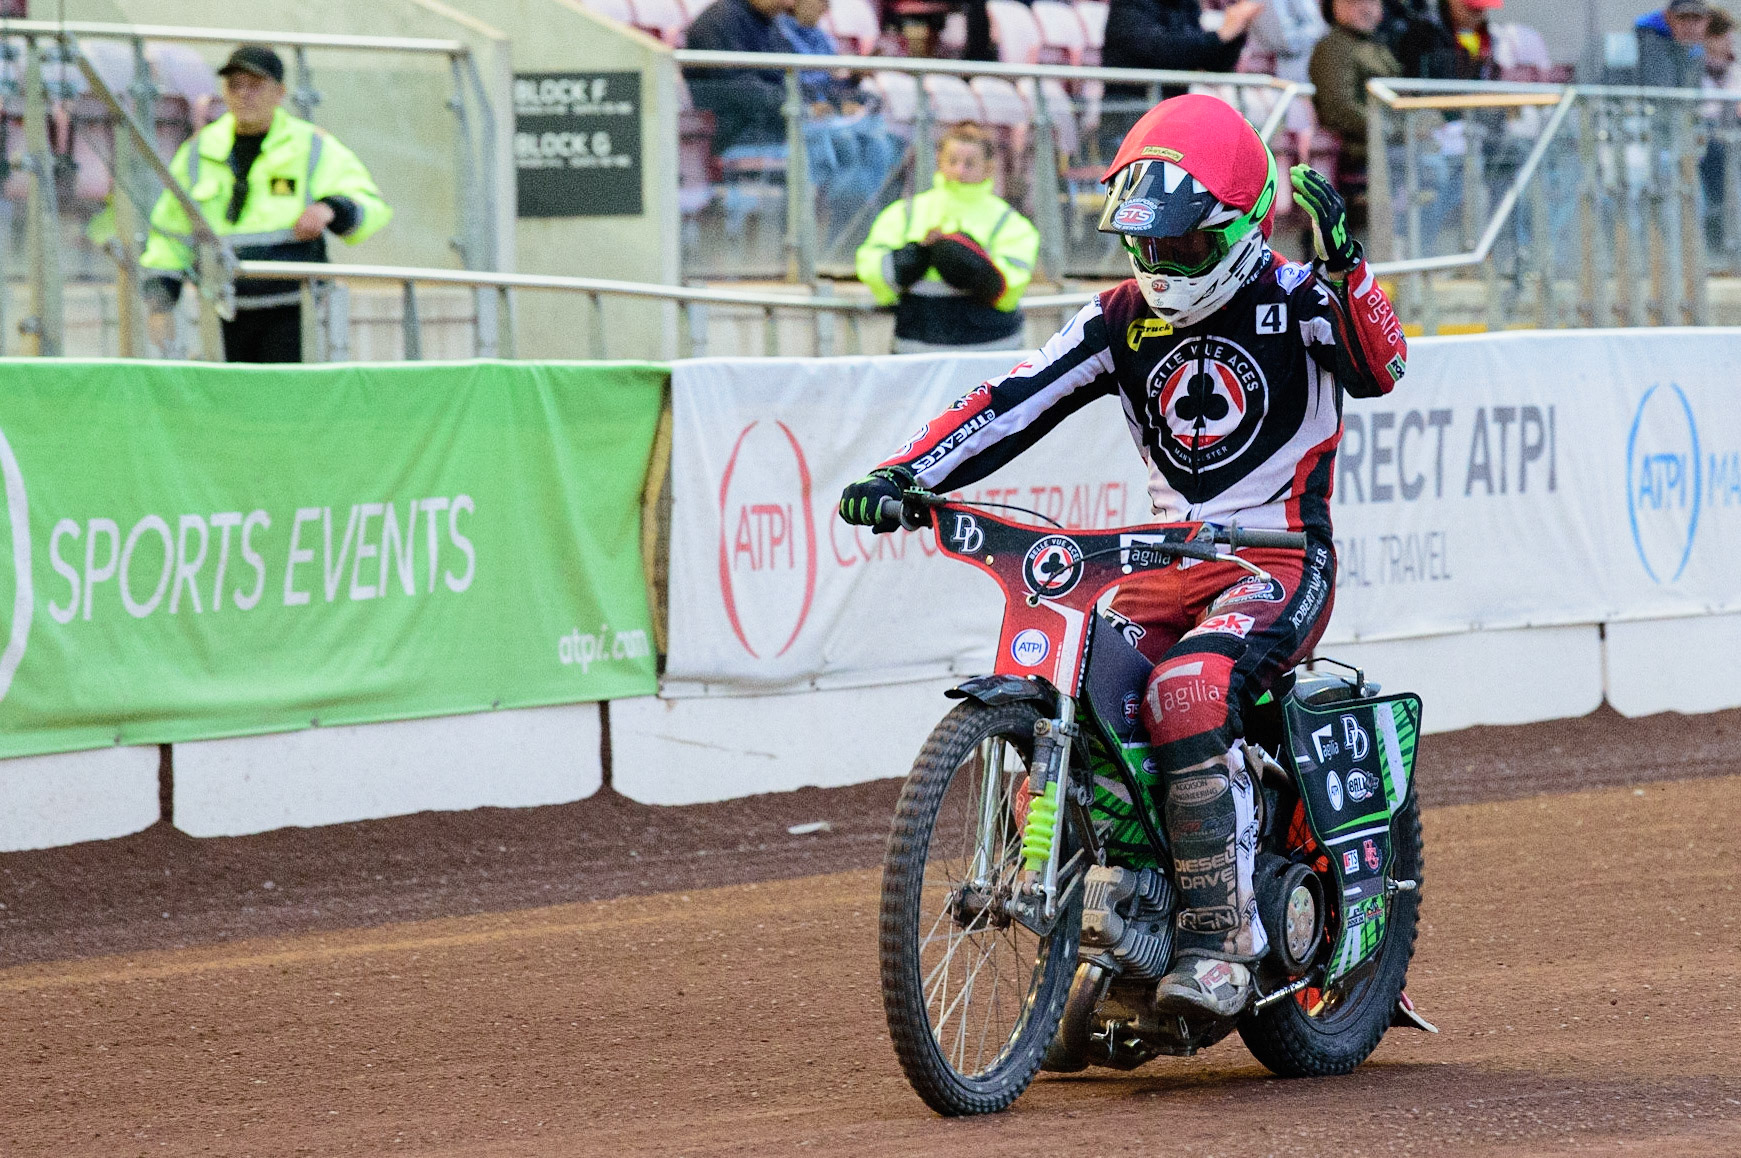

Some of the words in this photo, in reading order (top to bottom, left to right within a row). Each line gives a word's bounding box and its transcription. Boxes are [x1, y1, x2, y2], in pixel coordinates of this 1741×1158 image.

[514, 79, 588, 103] BLOCK
[591, 79, 606, 101] F
[514, 132, 588, 157] BLOCK
[591, 131, 611, 157] G
[1117, 208, 1153, 221] STS
[1261, 305, 1281, 332] 4
[1366, 289, 1402, 347] agilia
[1228, 354, 1259, 392] ACES
[1463, 405, 1557, 497] ATPI
[1639, 452, 1686, 510] ATPI
[733, 503, 794, 571] ATPI
[1029, 540, 1049, 560] BELLE
[1051, 538, 1067, 547] VUE
[1067, 545, 1081, 562] ACE
[48, 509, 271, 624] SPORTS
[283, 494, 475, 606] EVENTS
[1380, 530, 1452, 584] TRAVEL
[1292, 588, 1316, 630] ROBERT
[1018, 641, 1042, 653] ATPI
[1163, 679, 1220, 713] agilia
[1174, 849, 1236, 874] DIESEL
[1180, 867, 1234, 890] DAVE
